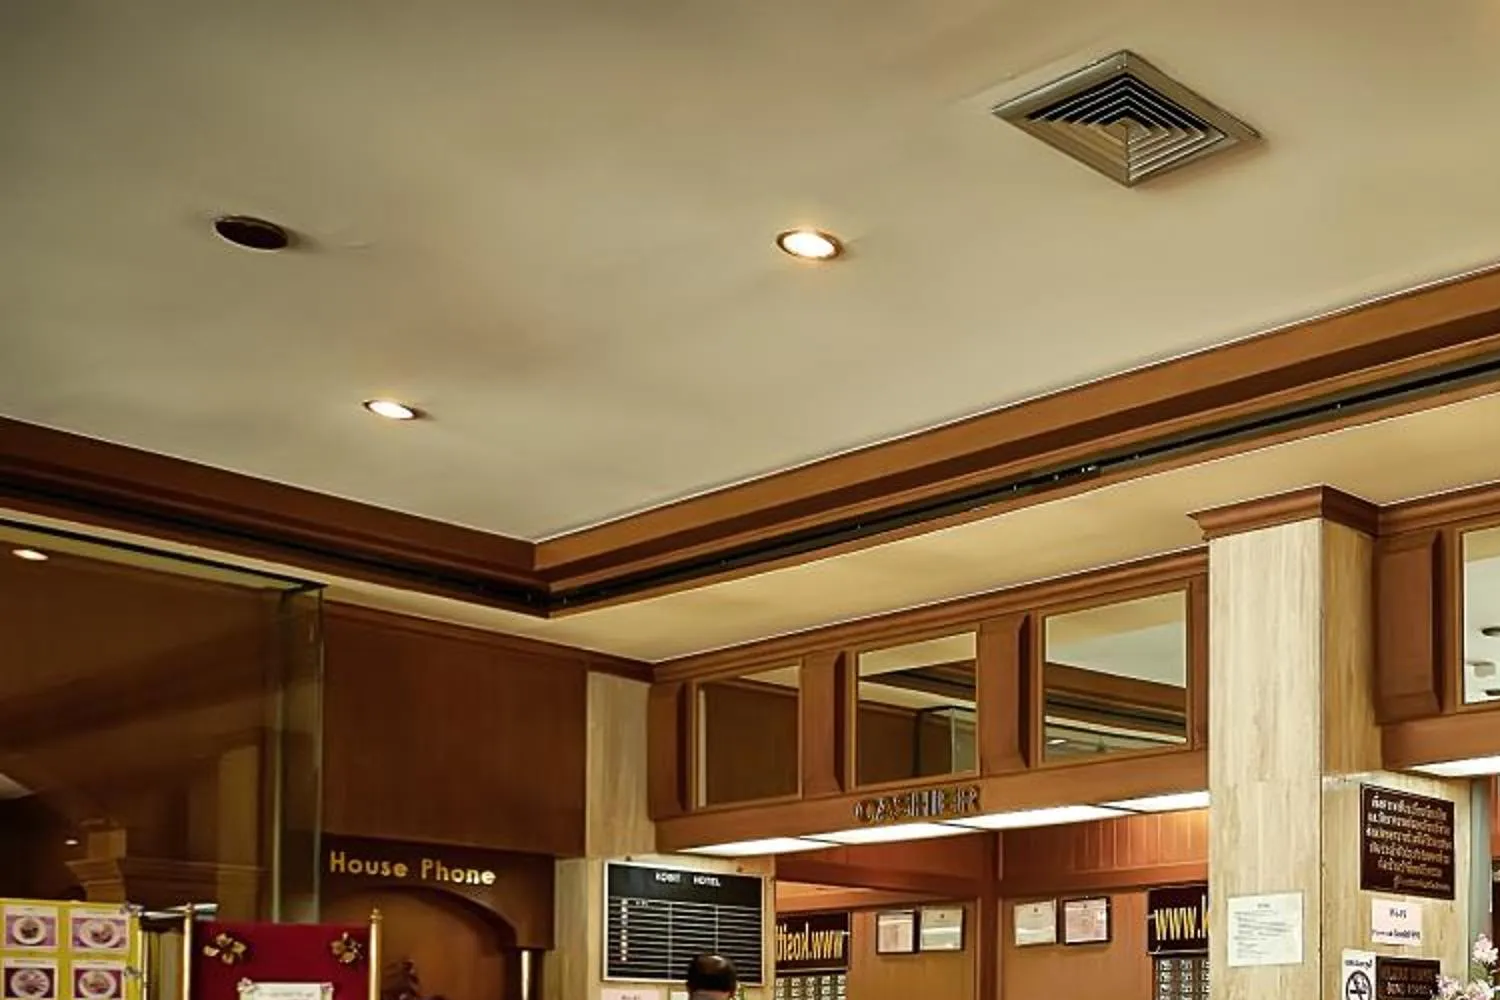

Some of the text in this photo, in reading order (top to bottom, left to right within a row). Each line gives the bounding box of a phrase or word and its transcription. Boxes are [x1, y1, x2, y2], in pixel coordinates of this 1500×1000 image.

[854, 783, 980, 822] CASHIER
[329, 850, 496, 885] House Phone
